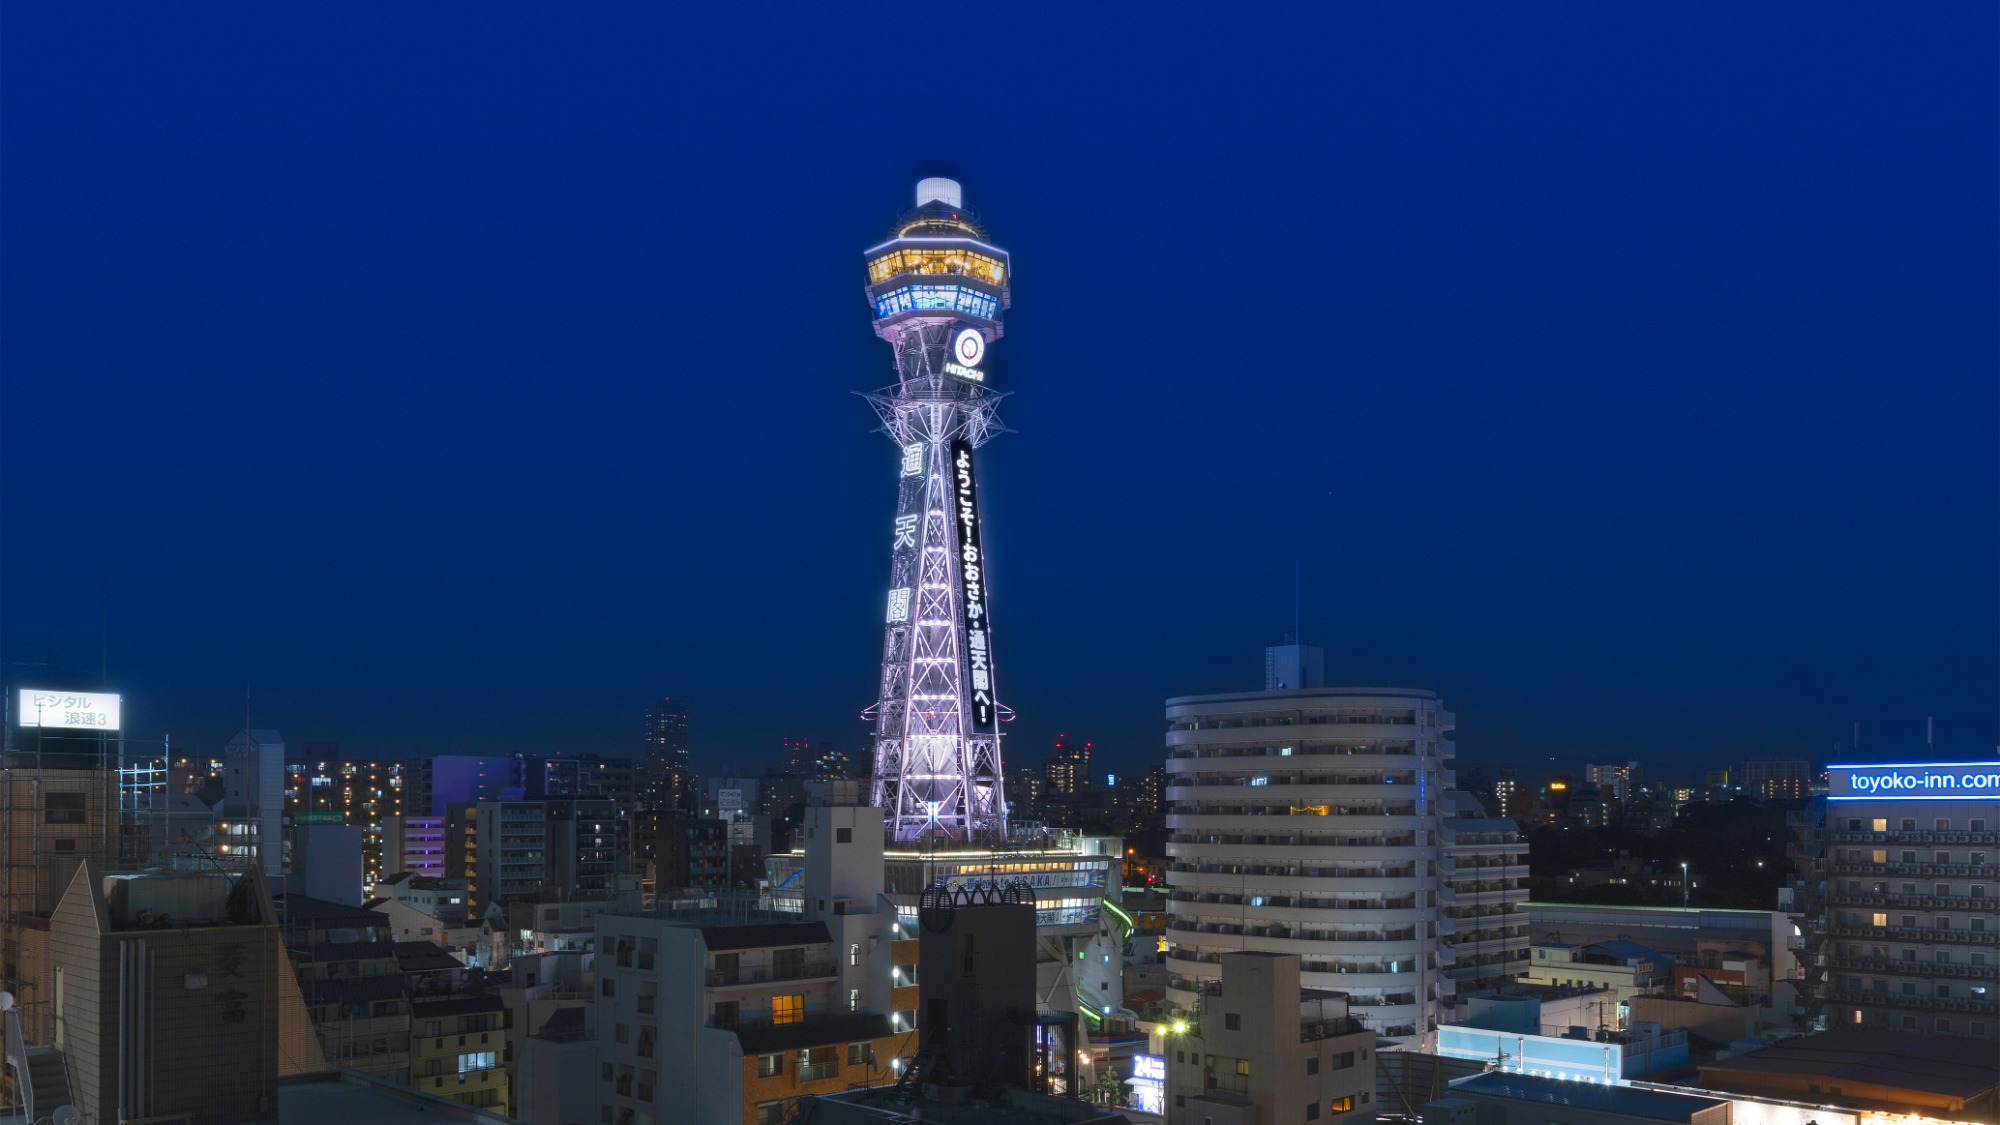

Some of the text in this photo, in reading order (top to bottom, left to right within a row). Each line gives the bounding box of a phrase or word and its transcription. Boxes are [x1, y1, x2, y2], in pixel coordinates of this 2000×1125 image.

[945, 362, 984, 382] HITACHI
[886, 442, 924, 623] 通天閣
[65, 711, 107, 726] 浪速3
[1134, 1055, 1152, 1078] 24
